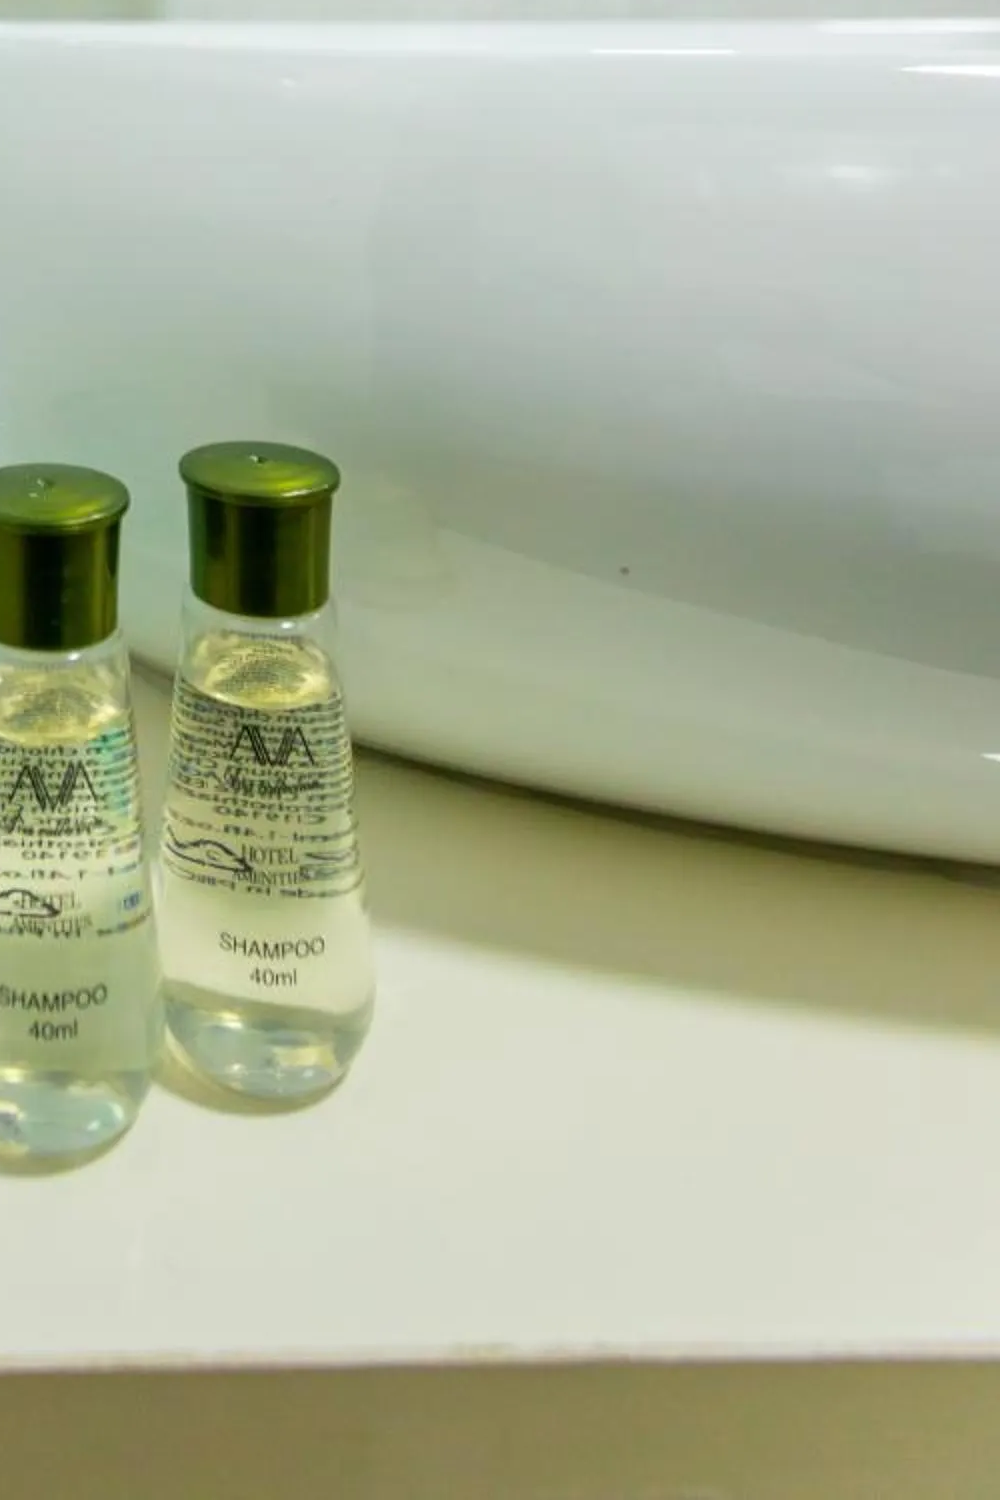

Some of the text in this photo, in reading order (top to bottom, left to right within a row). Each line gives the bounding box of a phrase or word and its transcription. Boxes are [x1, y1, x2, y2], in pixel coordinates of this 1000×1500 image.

[228, 725, 315, 767] AVA
[7, 760, 99, 812] AVA
[219, 931, 326, 961] SHAMPOO
[250, 968, 298, 988] 40ml
[28, 1018, 79, 1042] 40ml
